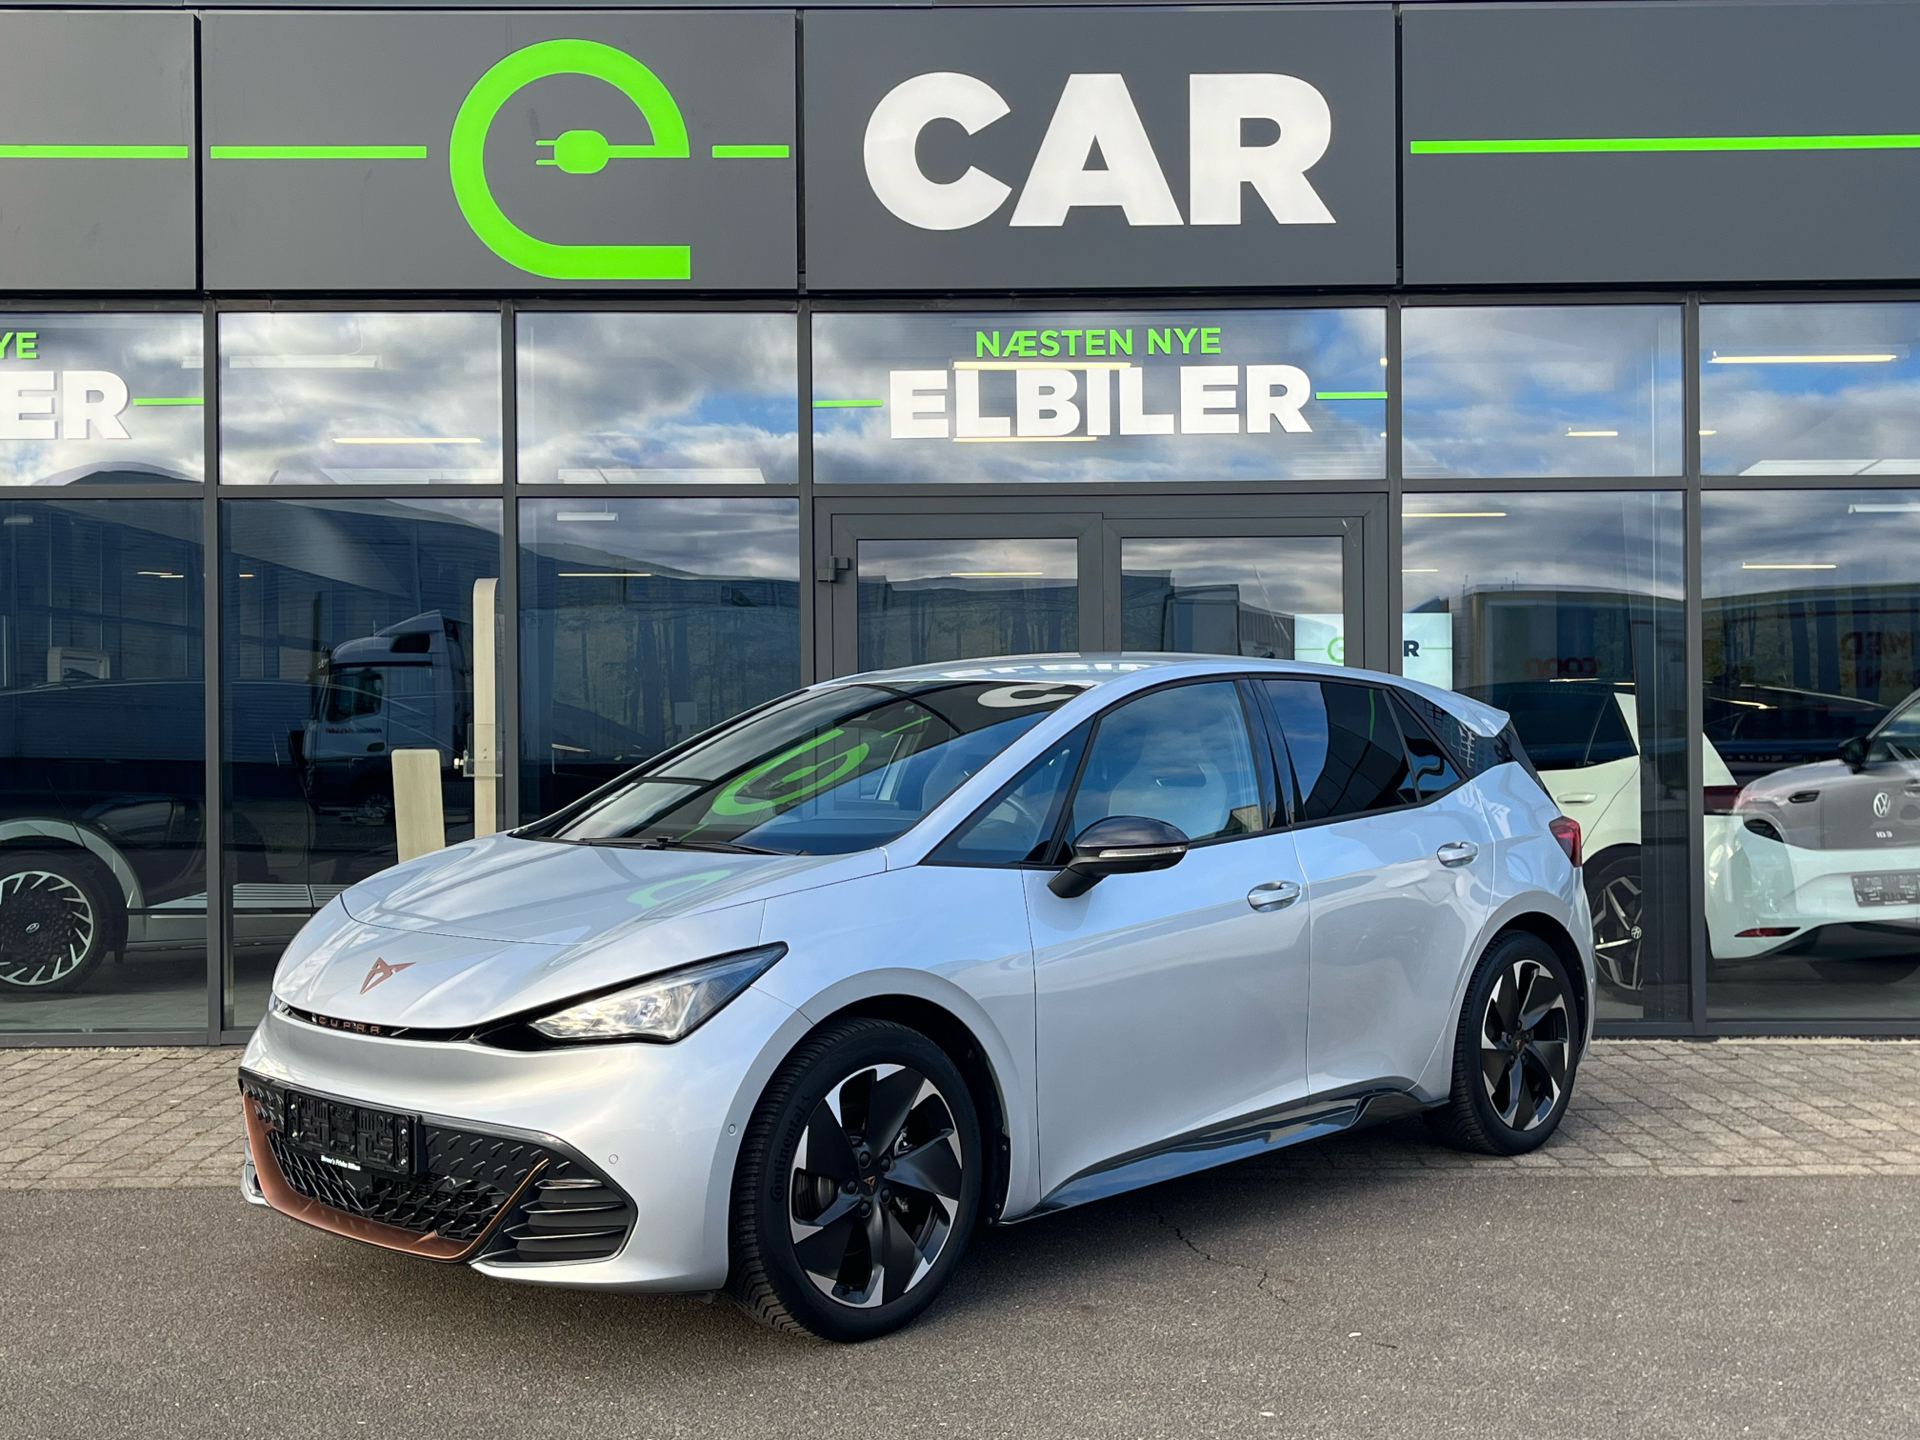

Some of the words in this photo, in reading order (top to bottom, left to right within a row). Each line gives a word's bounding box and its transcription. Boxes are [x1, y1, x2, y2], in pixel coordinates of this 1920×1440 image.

[864, 71, 1336, 231] CAR
[976, 328, 1134, 357] NÆSTEN
[1148, 327, 1222, 355] NYE
[889, 364, 1313, 439] ELBILER
[318, 1015, 381, 1035] CUPRA
[769, 1104, 807, 1203] Continental
